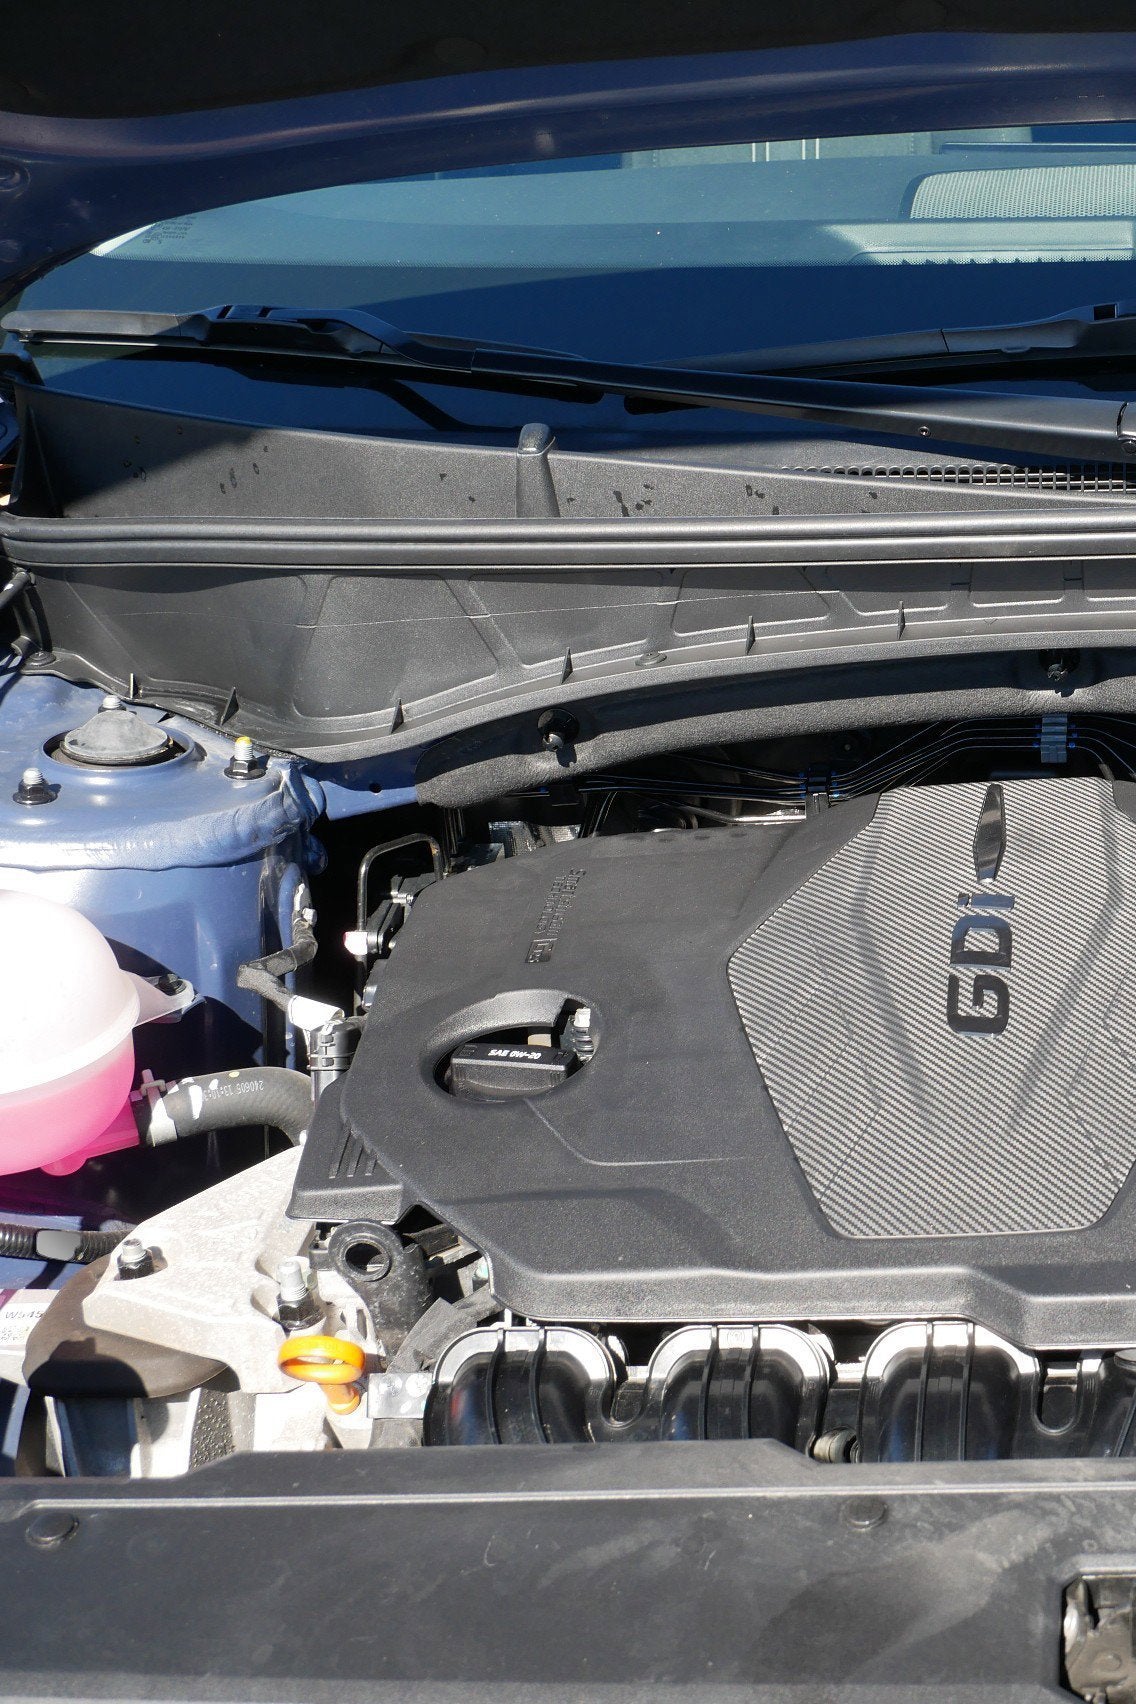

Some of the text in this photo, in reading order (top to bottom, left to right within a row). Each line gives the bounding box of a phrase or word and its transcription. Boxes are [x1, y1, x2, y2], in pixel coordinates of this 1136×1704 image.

[946, 893, 1014, 1037] GDi
[487, 1049, 542, 1060] SAE 0W-20
[235, 1080, 264, 1095] 240605
